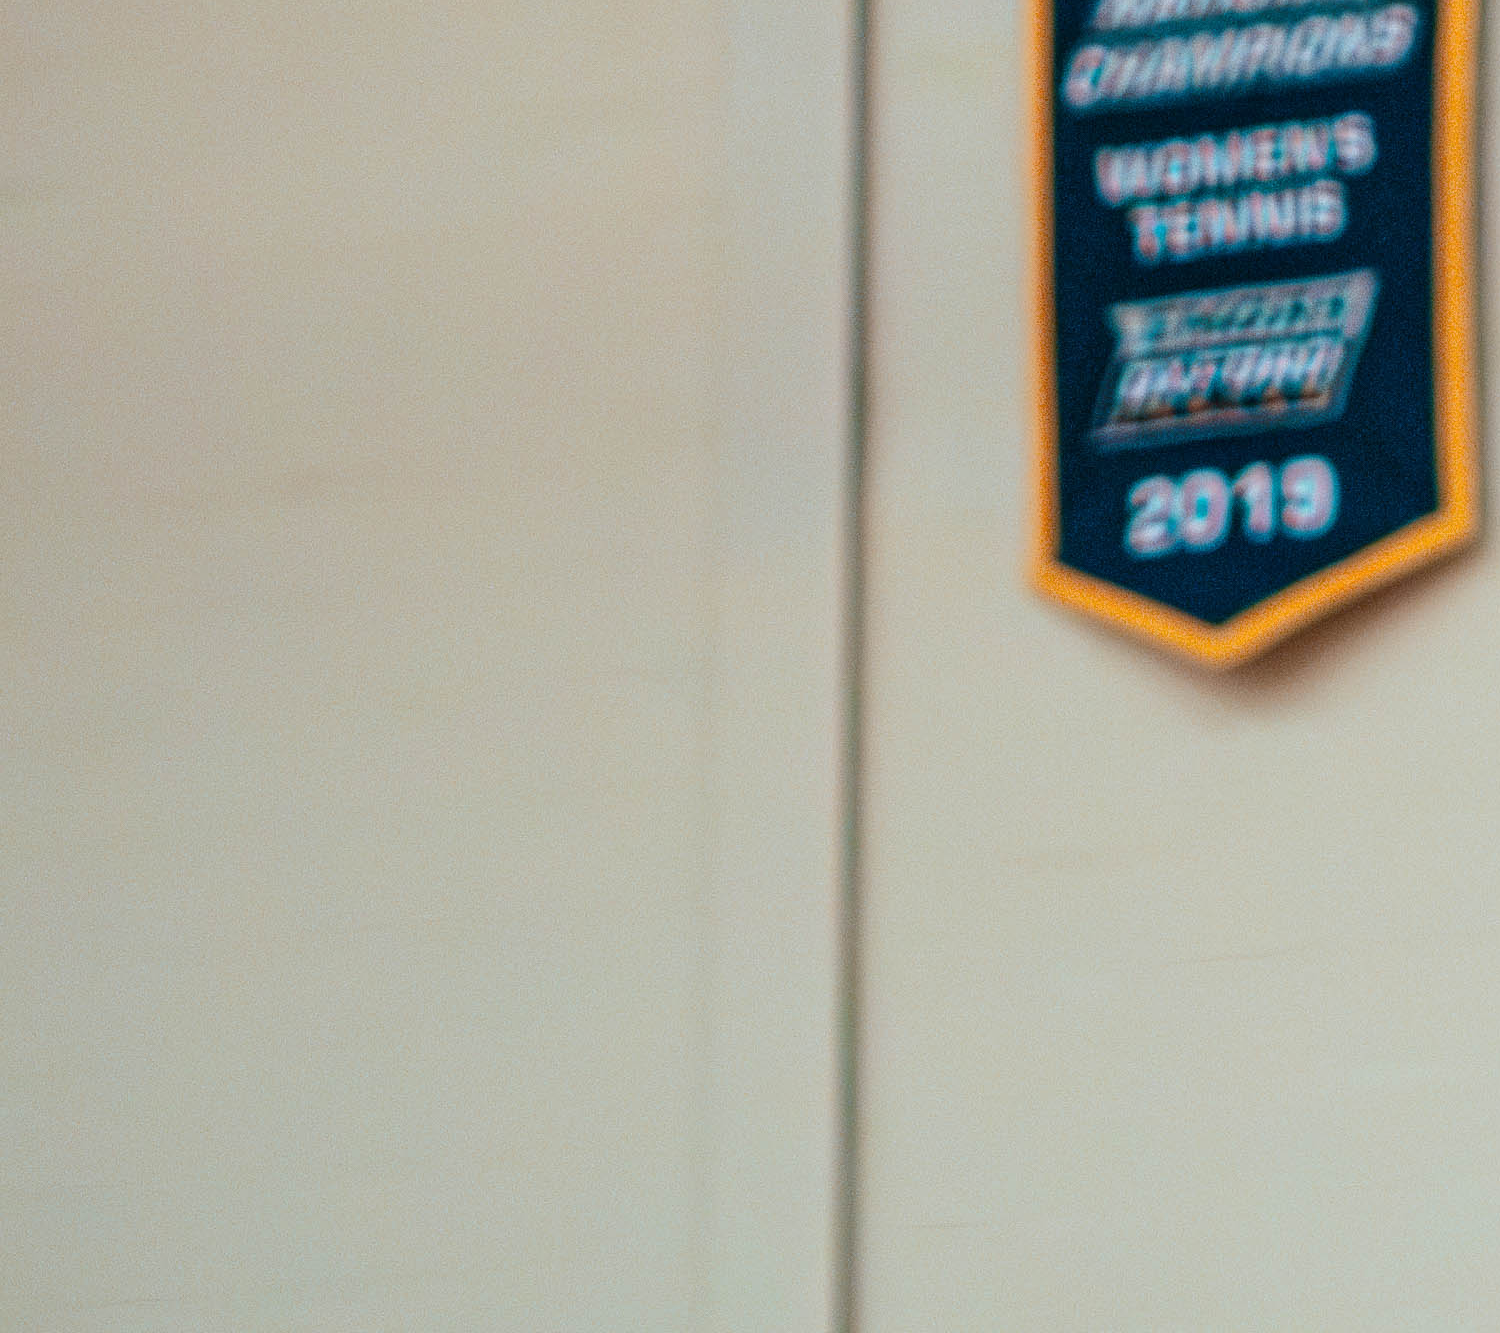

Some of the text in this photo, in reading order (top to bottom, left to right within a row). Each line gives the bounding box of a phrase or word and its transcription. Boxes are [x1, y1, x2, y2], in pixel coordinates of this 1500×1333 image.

[1069, 8, 1413, 104] CHAMPIONS
[1103, 120, 1371, 201] WOMEN'S
[1134, 186, 1341, 260] TENNIS
[1132, 463, 1333, 554] 2019
